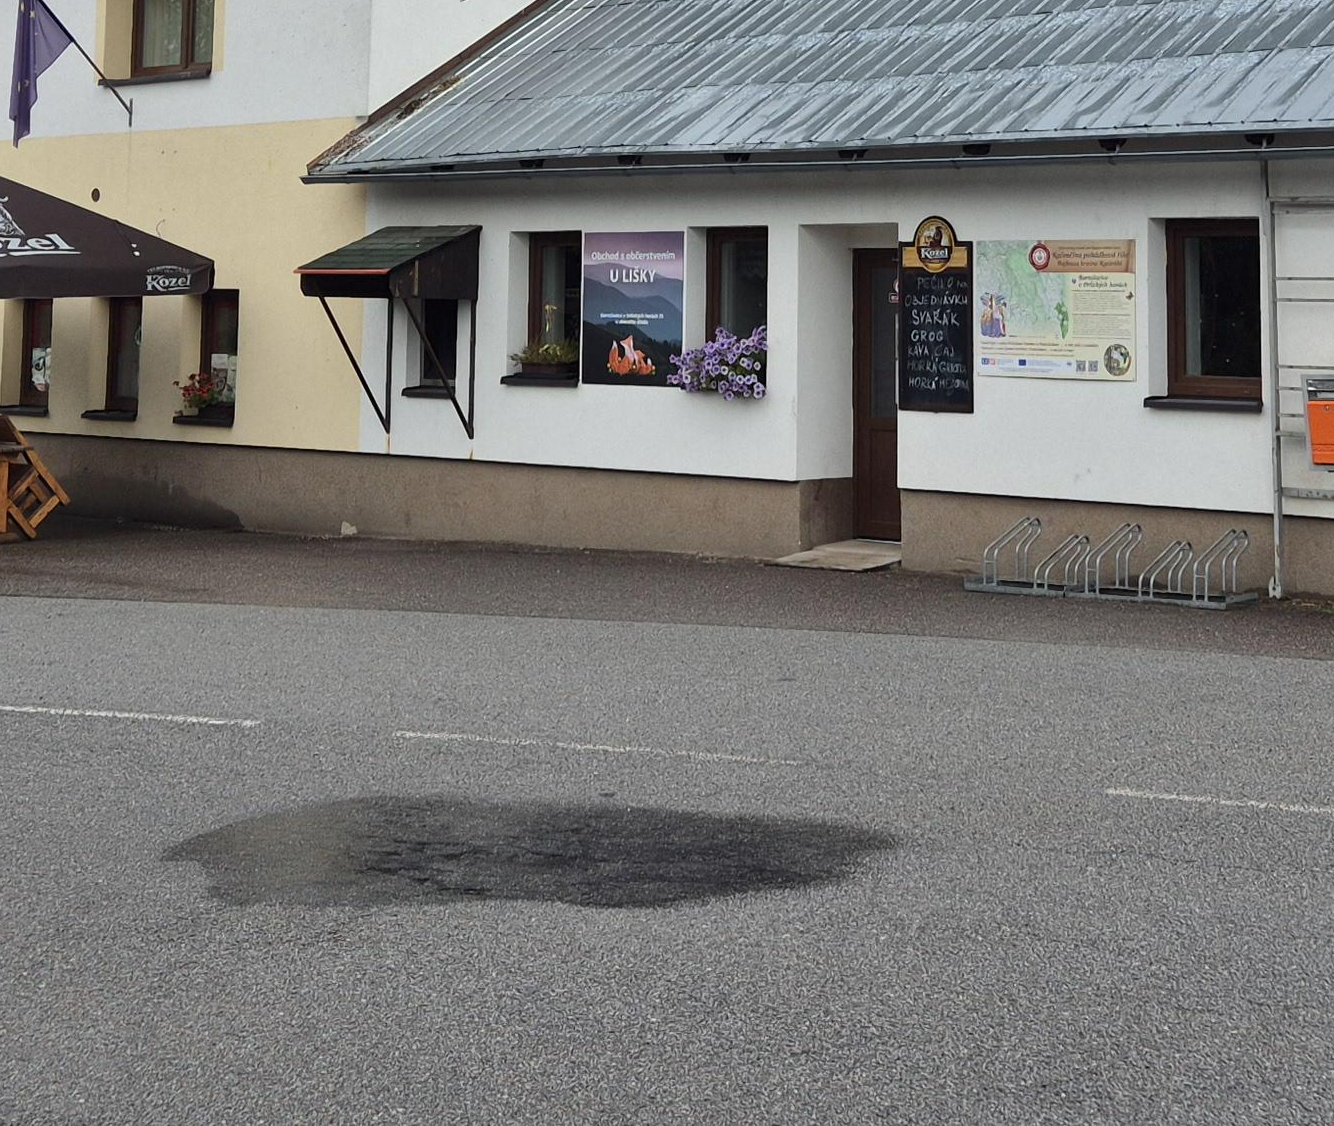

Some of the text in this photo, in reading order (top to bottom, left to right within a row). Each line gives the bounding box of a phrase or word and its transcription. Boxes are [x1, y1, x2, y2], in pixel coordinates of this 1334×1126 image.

[591, 250, 619, 260] Obchod
[920, 247, 951, 259] Kozel
[610, 265, 656, 283] U LIŠKY
[146, 274, 192, 291] Kozel
[912, 308, 960, 326] SVAŘÁK
[911, 330, 943, 342] GROG
